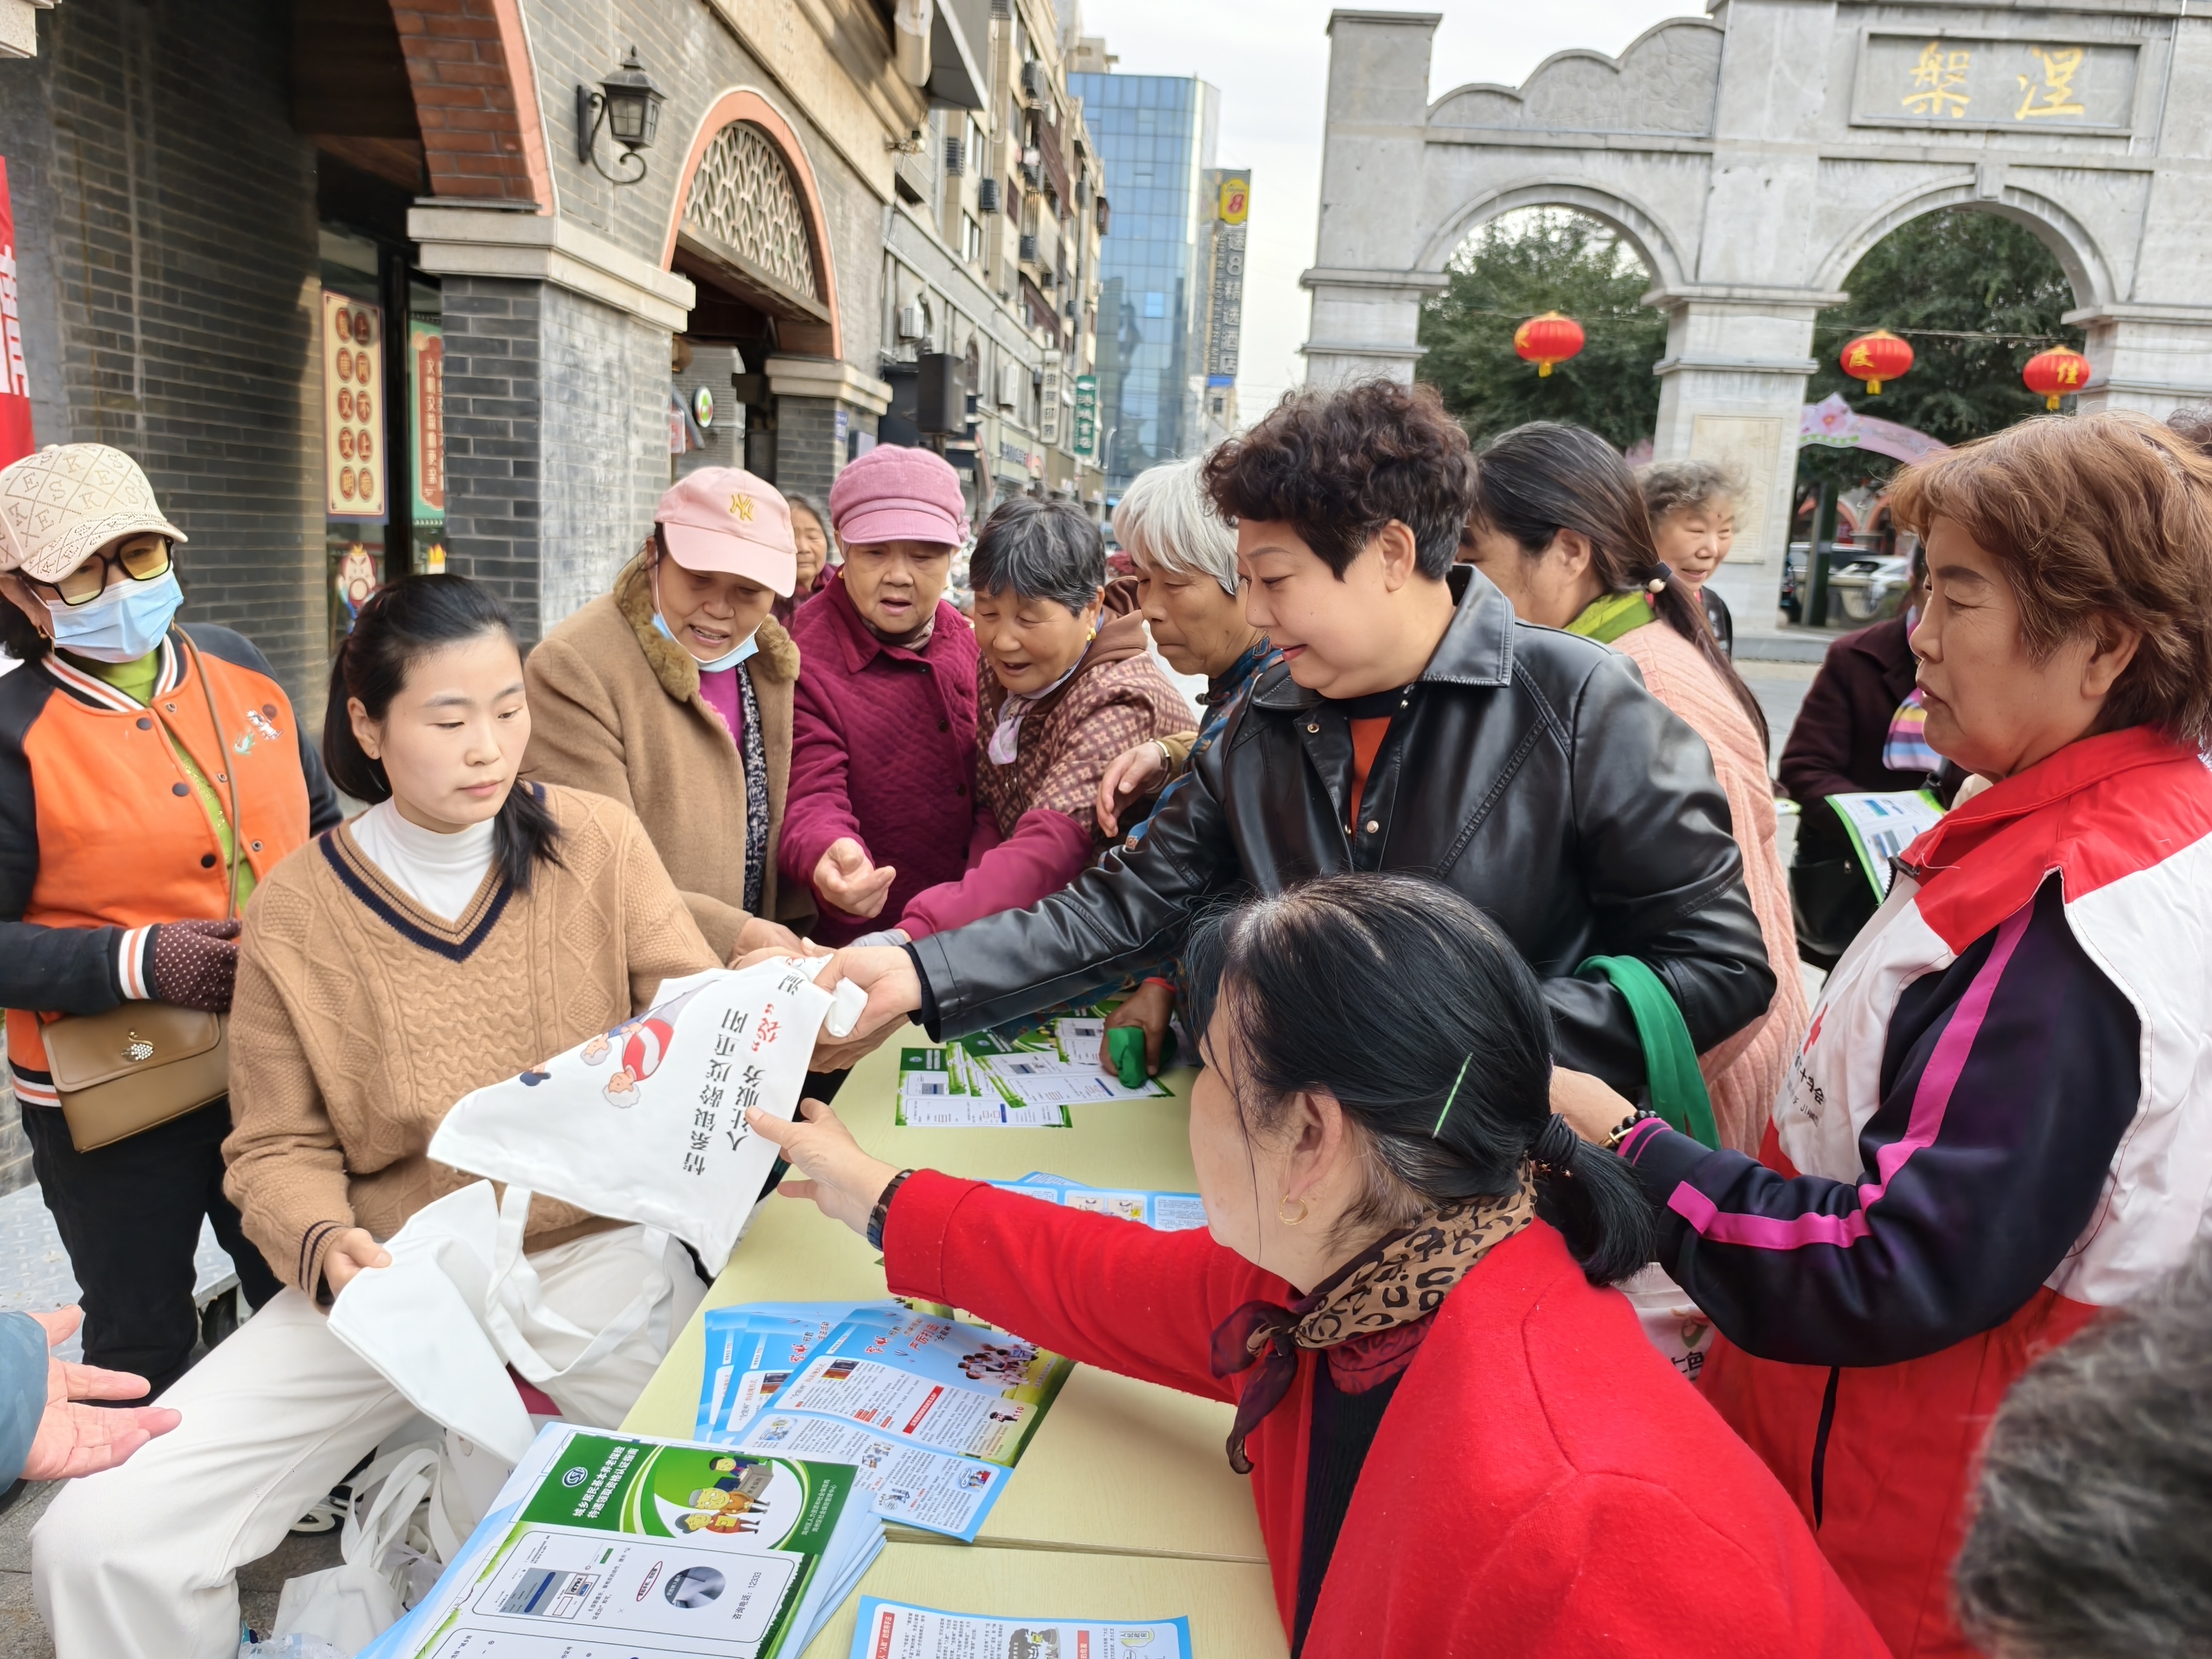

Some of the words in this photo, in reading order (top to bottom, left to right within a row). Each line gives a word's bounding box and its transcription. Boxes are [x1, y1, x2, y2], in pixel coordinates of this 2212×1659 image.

[1228, 193, 1244, 214] 8
[1218, 231, 1246, 375] 速8精选酒店
[1849, 344, 1875, 368] 度
[2056, 360, 2078, 384] 佳
[730, 493, 754, 522] NY
[683, 1008, 749, 1176] 情系银龄度重阳
[909, 1323, 940, 1352] 严厉打击
[1013, 1406, 1024, 1420] 110
[572, 1446, 626, 1518] 城乡居民基本养老保险
[586, 1447, 639, 1519] 待遇领取资格认证指南
